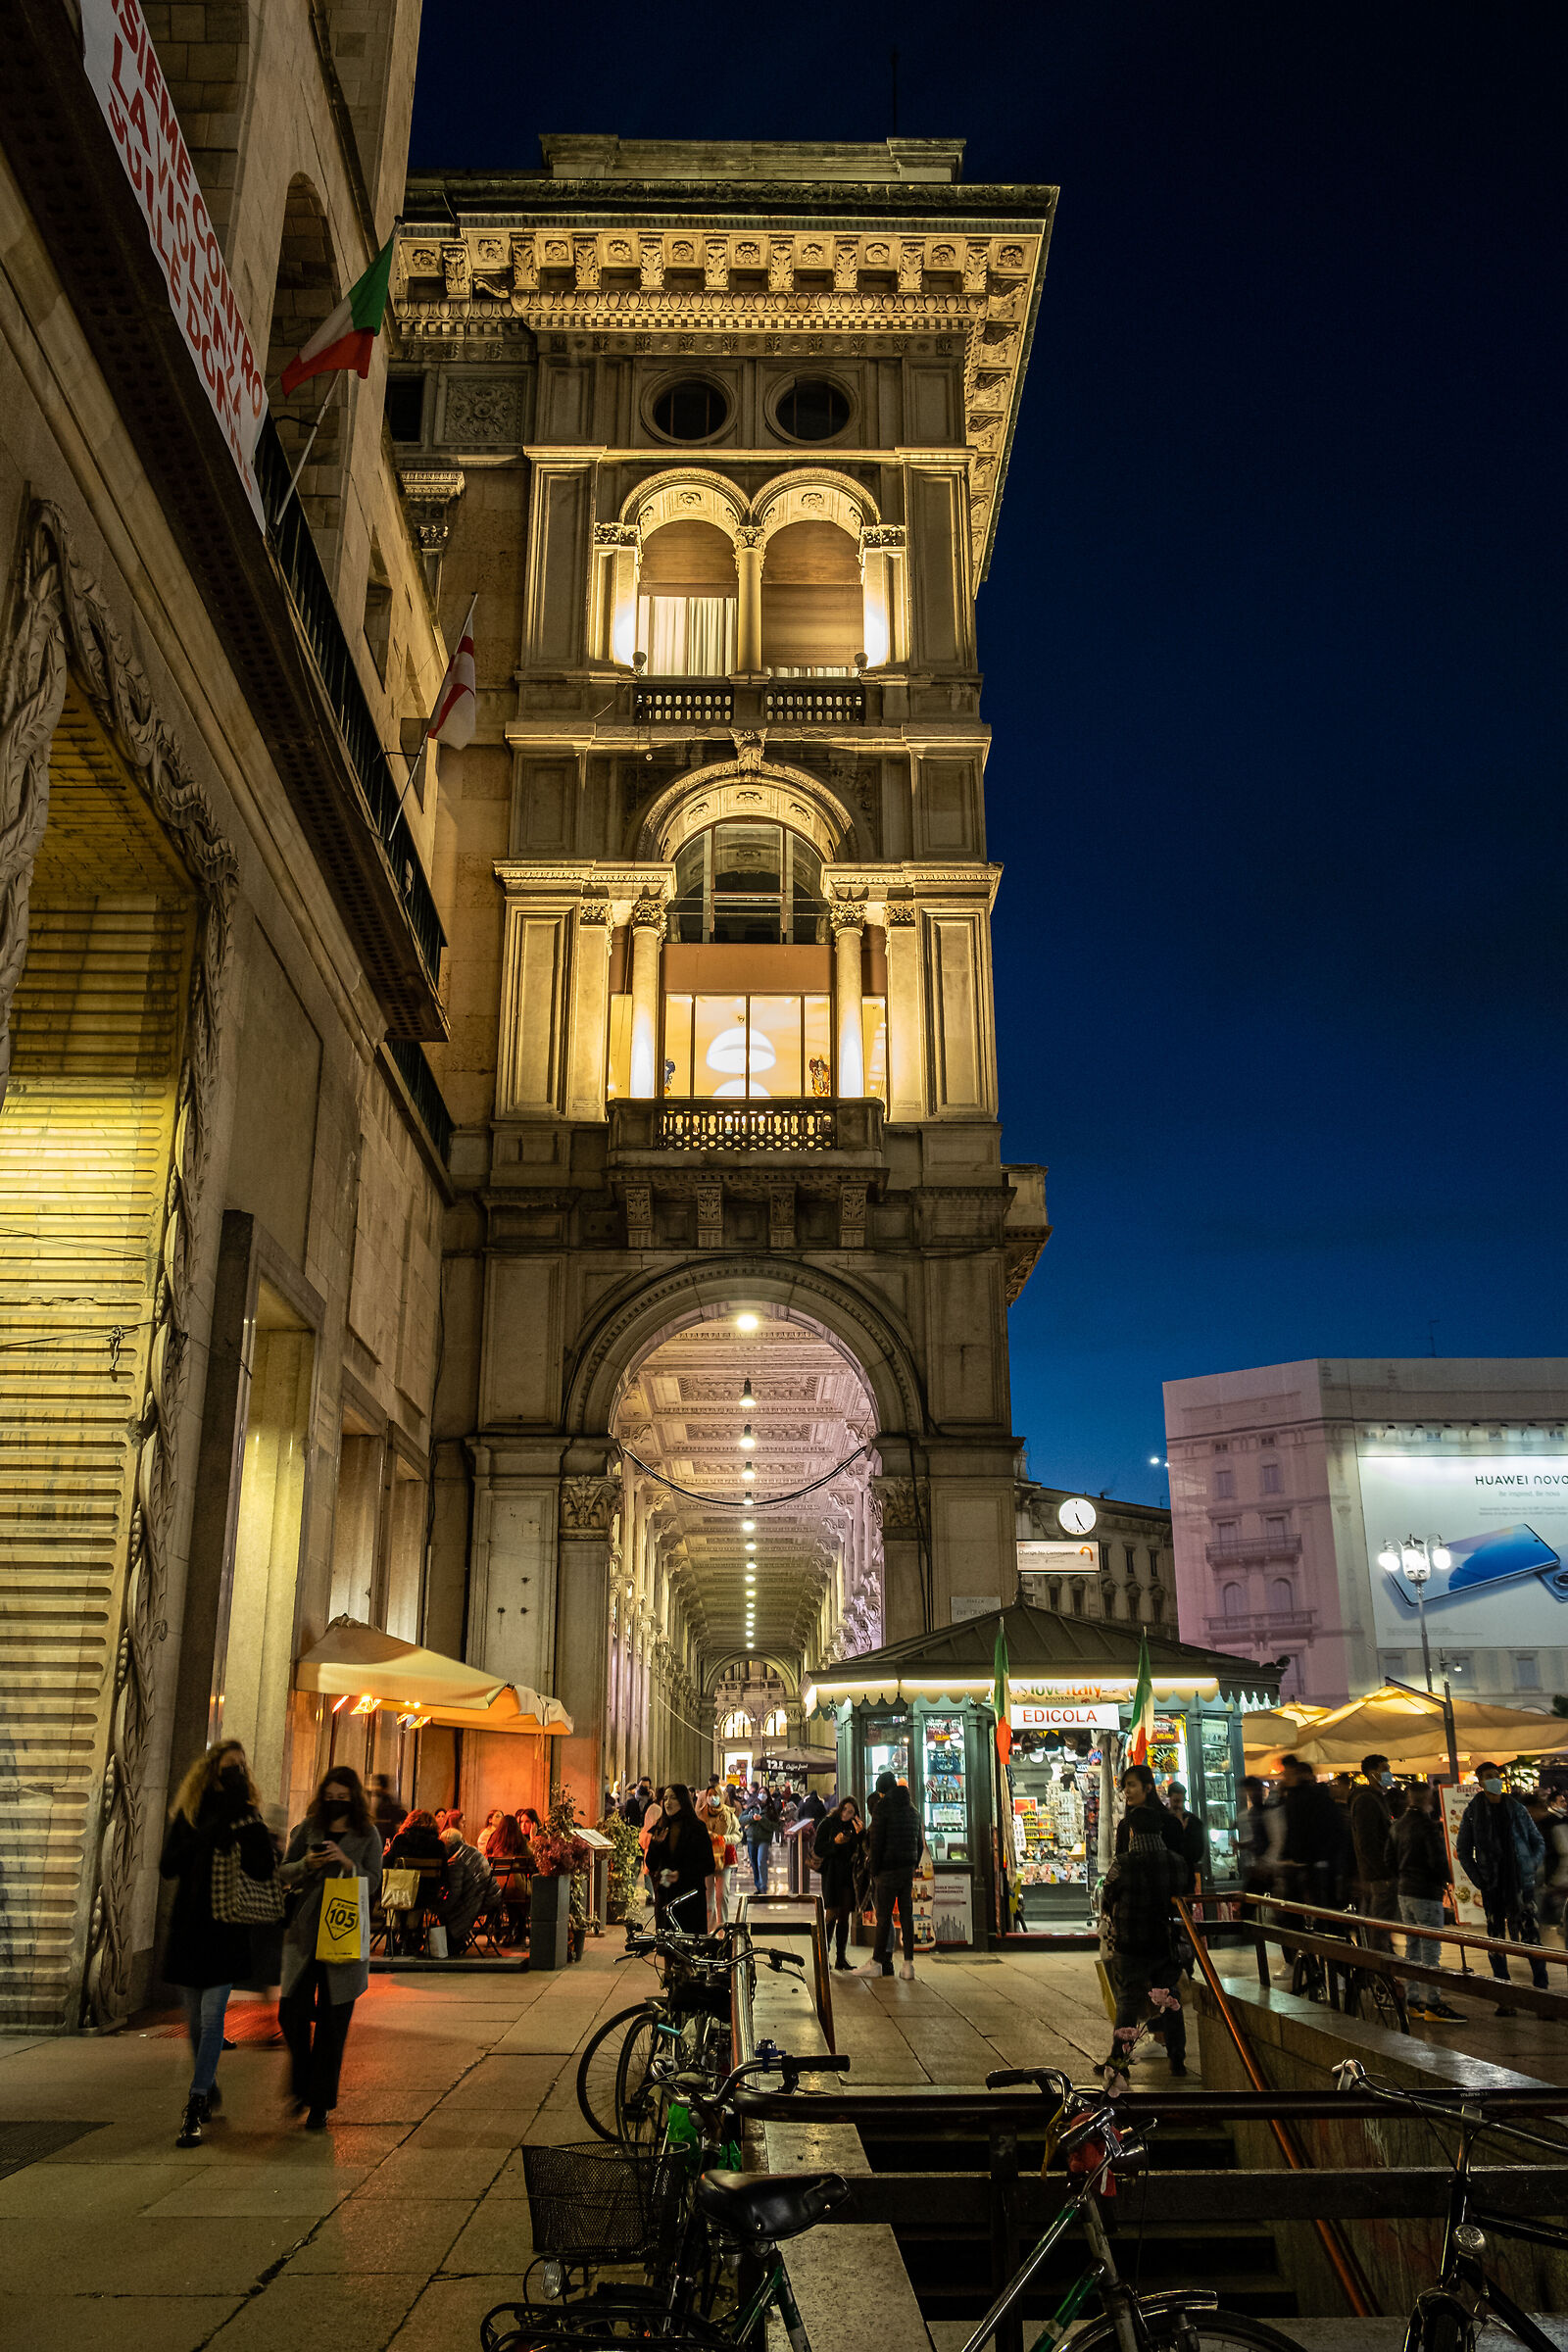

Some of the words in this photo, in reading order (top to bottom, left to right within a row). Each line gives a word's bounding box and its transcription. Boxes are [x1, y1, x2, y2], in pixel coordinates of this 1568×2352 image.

[108, 82, 181, 309] SULLE
[112, 32, 152, 158] LA
[156, 125, 242, 431] VIOLENZA
[192, 193, 263, 419] CONTRO
[1475, 1475, 1529, 1485] HUAWEI
[1022, 1709, 1098, 1723] EDICOLA
[329, 1908, 357, 1929] 105
